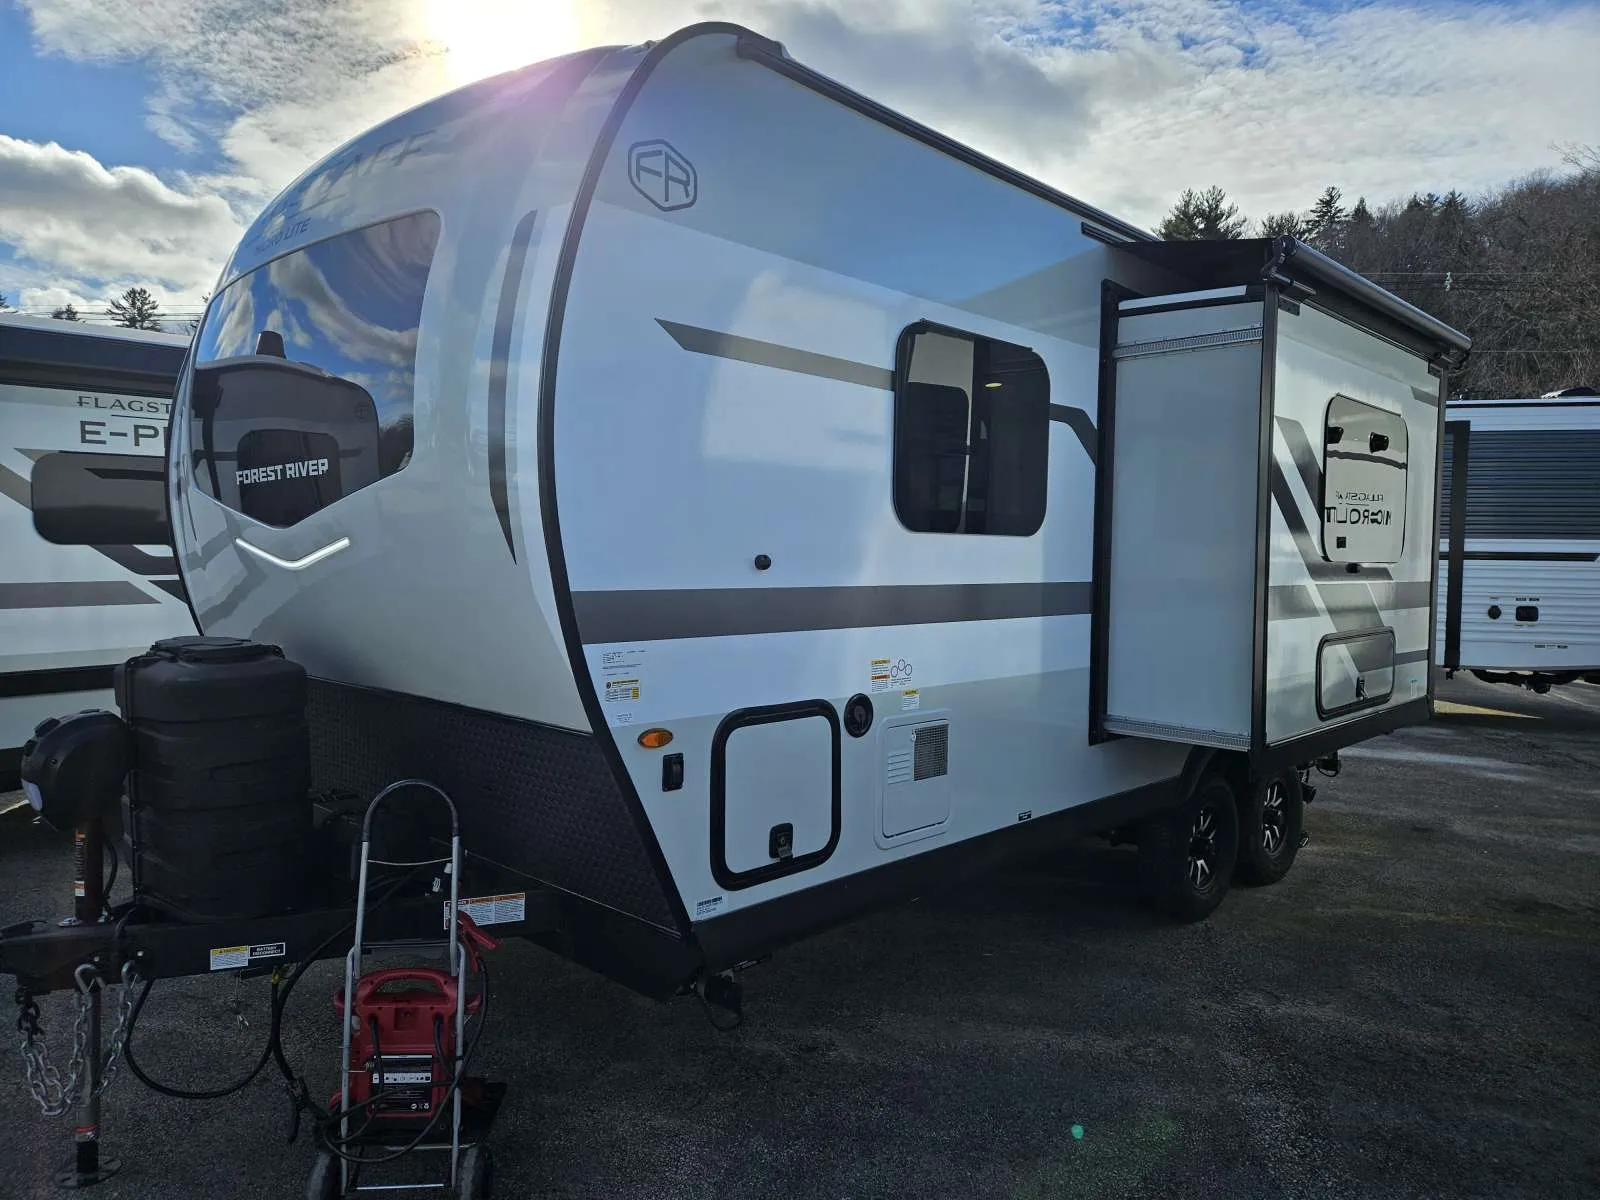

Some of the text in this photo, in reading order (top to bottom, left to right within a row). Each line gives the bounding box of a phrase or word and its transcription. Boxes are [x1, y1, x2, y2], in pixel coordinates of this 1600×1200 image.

[284, 217, 312, 240] LITE
[235, 458, 329, 485] FOREST RIVER
